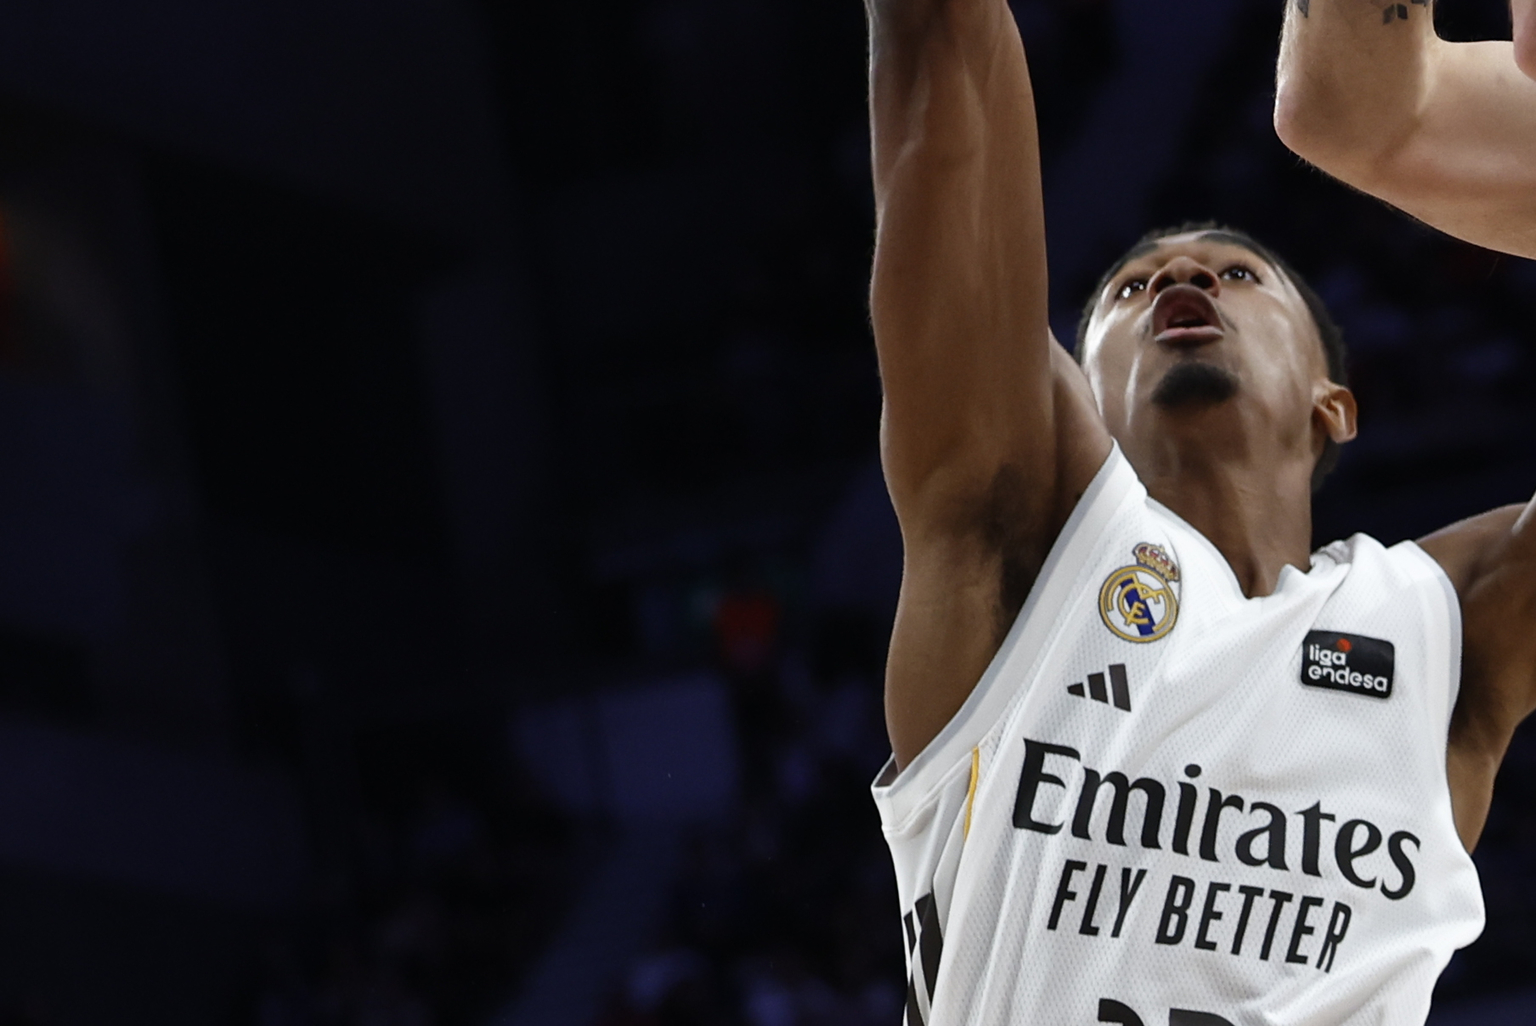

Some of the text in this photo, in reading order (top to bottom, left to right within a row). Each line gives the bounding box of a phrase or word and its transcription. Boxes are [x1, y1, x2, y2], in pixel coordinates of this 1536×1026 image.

[1308, 665, 1388, 692] endesa
[1309, 643, 1346, 666] liga
[1012, 737, 1421, 901] Emirates
[1047, 859, 1353, 973] FLY BETTER
